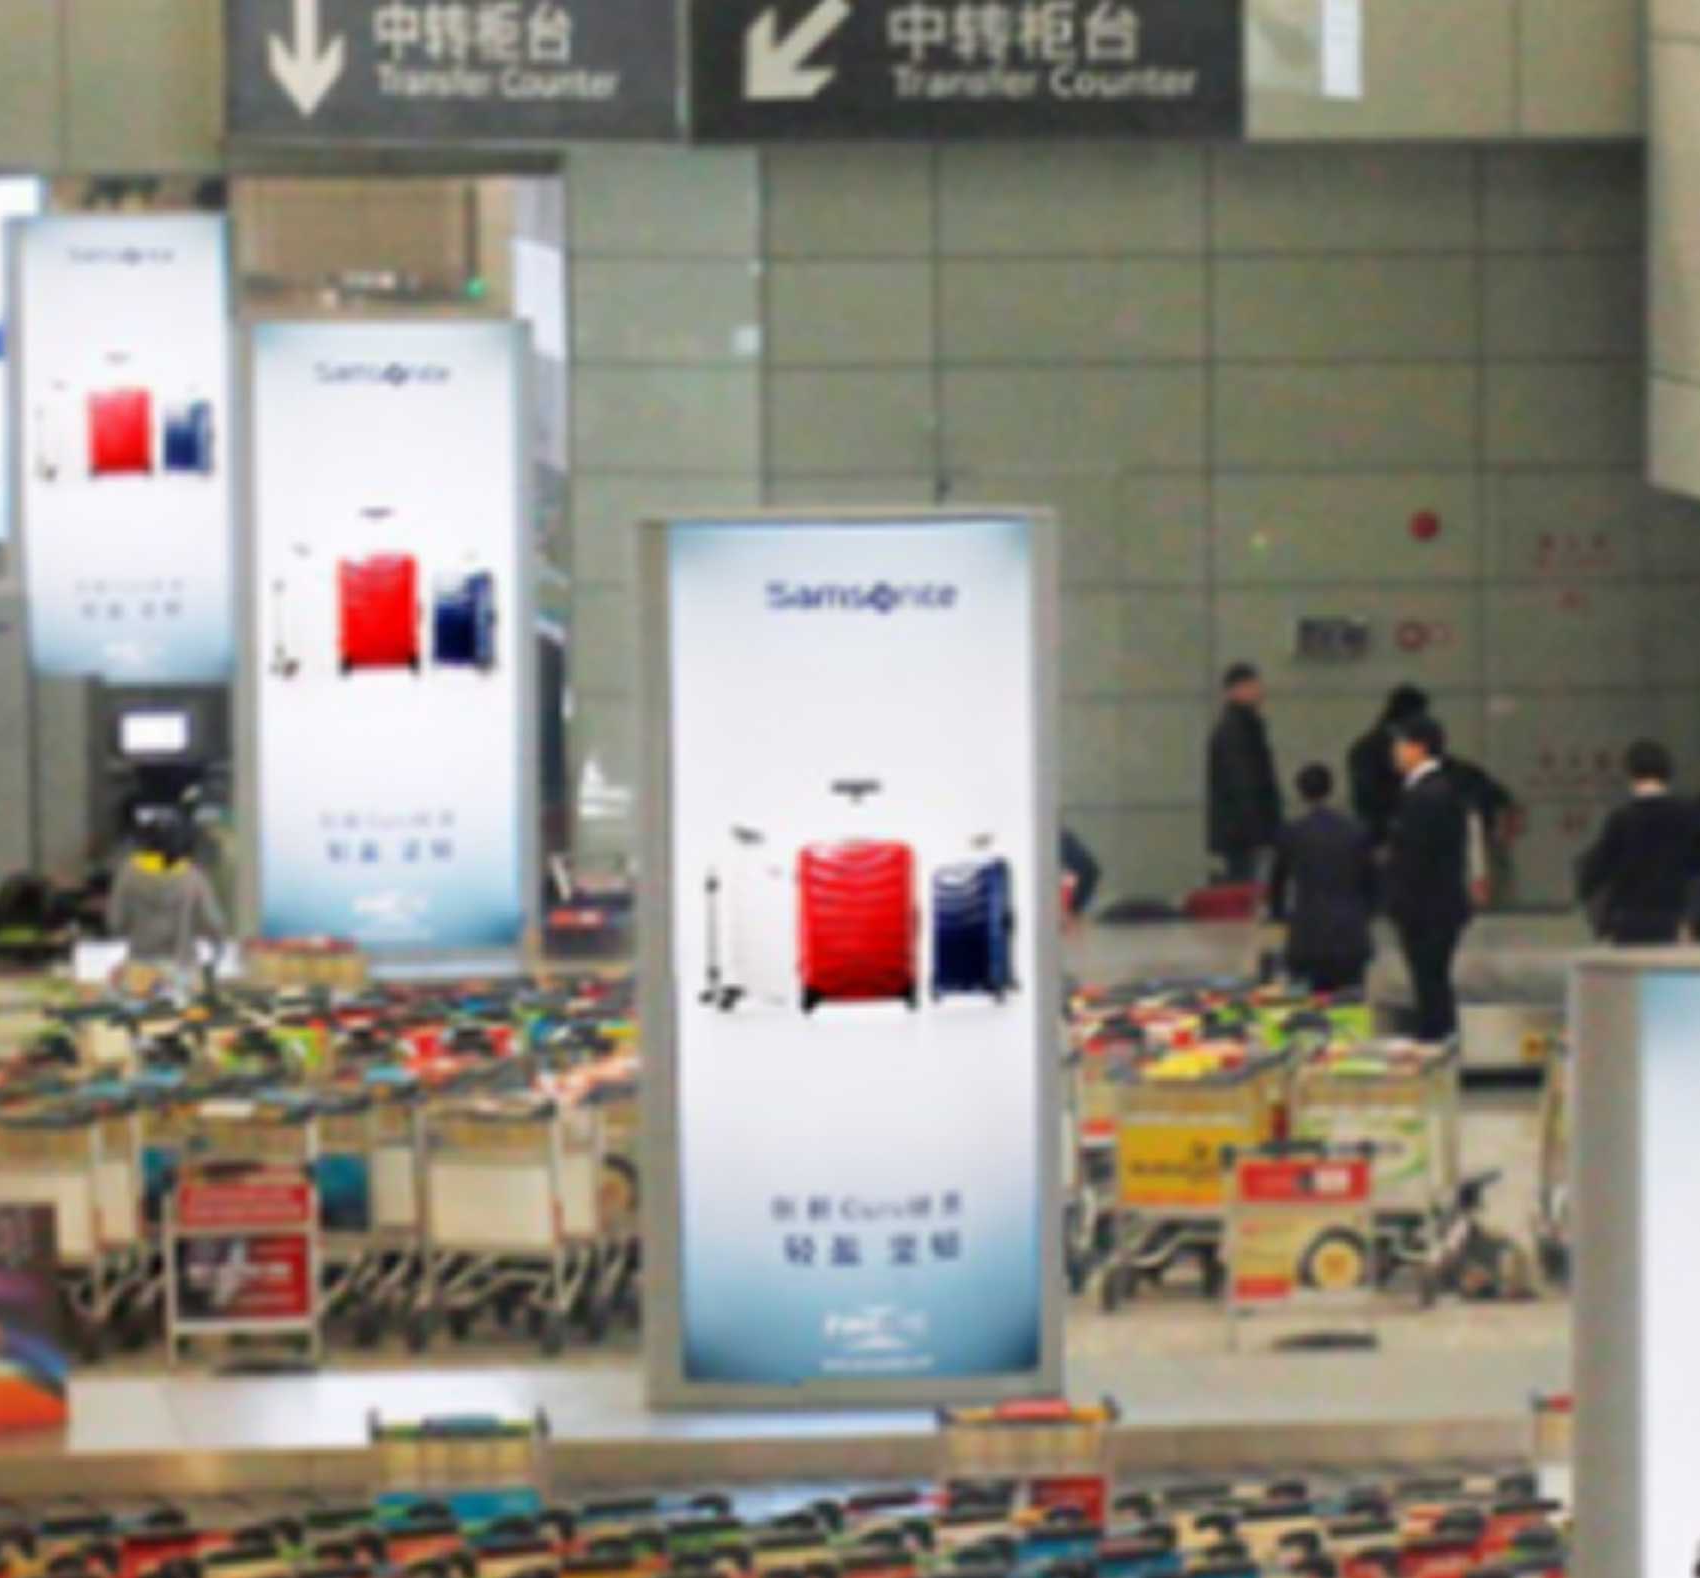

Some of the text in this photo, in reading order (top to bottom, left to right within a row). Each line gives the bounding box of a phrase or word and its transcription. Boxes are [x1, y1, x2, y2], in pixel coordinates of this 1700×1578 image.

[373, 0, 571, 62] 中转柜台
[888, 0, 1139, 62] 中转柜台
[376, 64, 619, 99] Transfer Counter
[894, 65, 1196, 98] Transfer Counter
[764, 580, 959, 616] Samsonite
